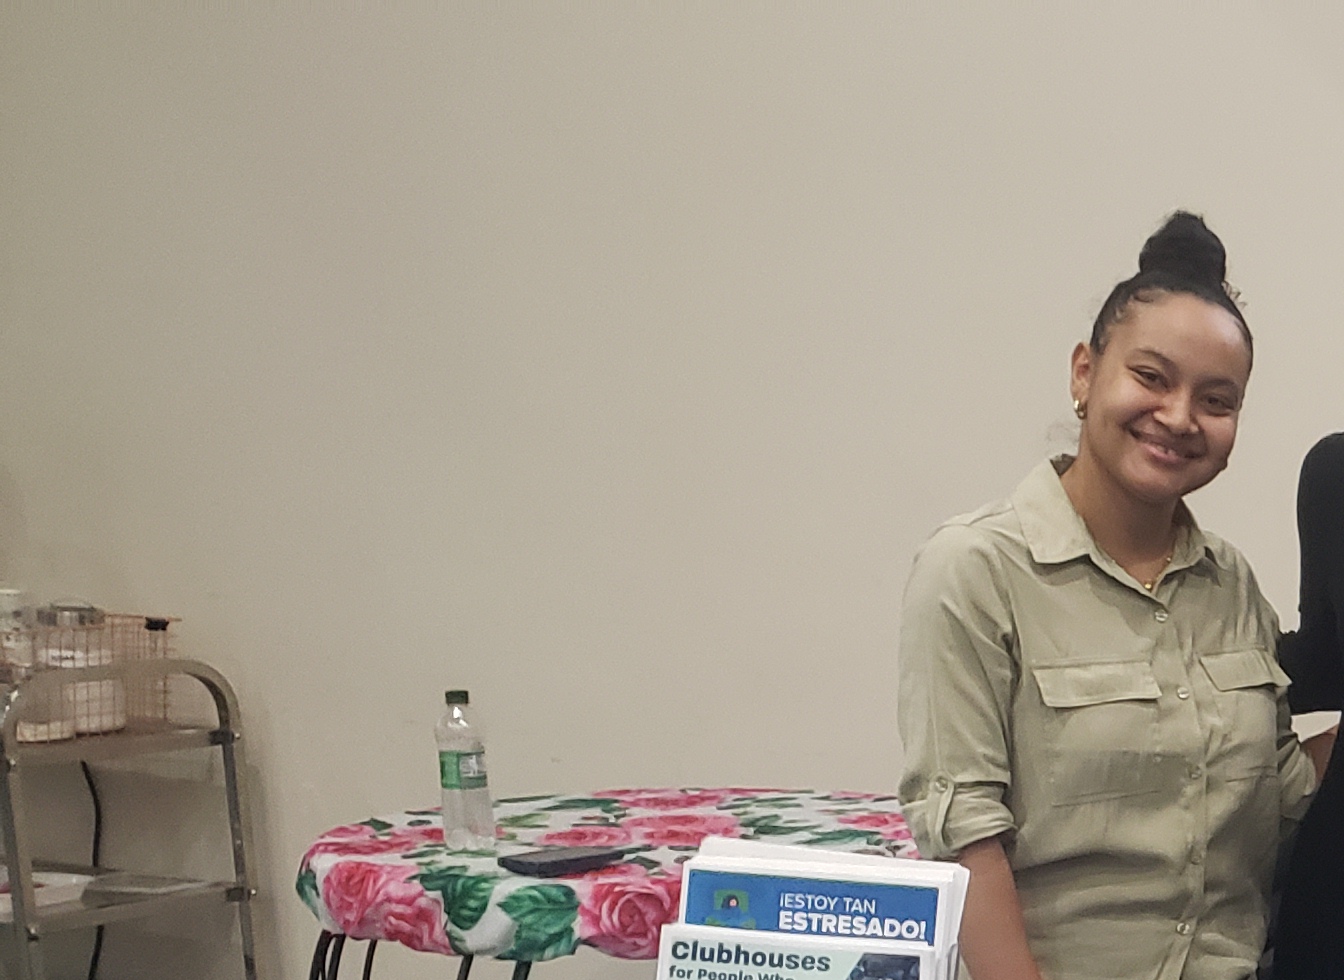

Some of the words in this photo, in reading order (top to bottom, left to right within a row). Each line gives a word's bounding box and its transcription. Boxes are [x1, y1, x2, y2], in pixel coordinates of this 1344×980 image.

[843, 897, 876, 914] TAN
[779, 910, 926, 939] ESTRESADO!
[671, 940, 831, 972] Clubhouses
[669, 964, 692, 980] for
